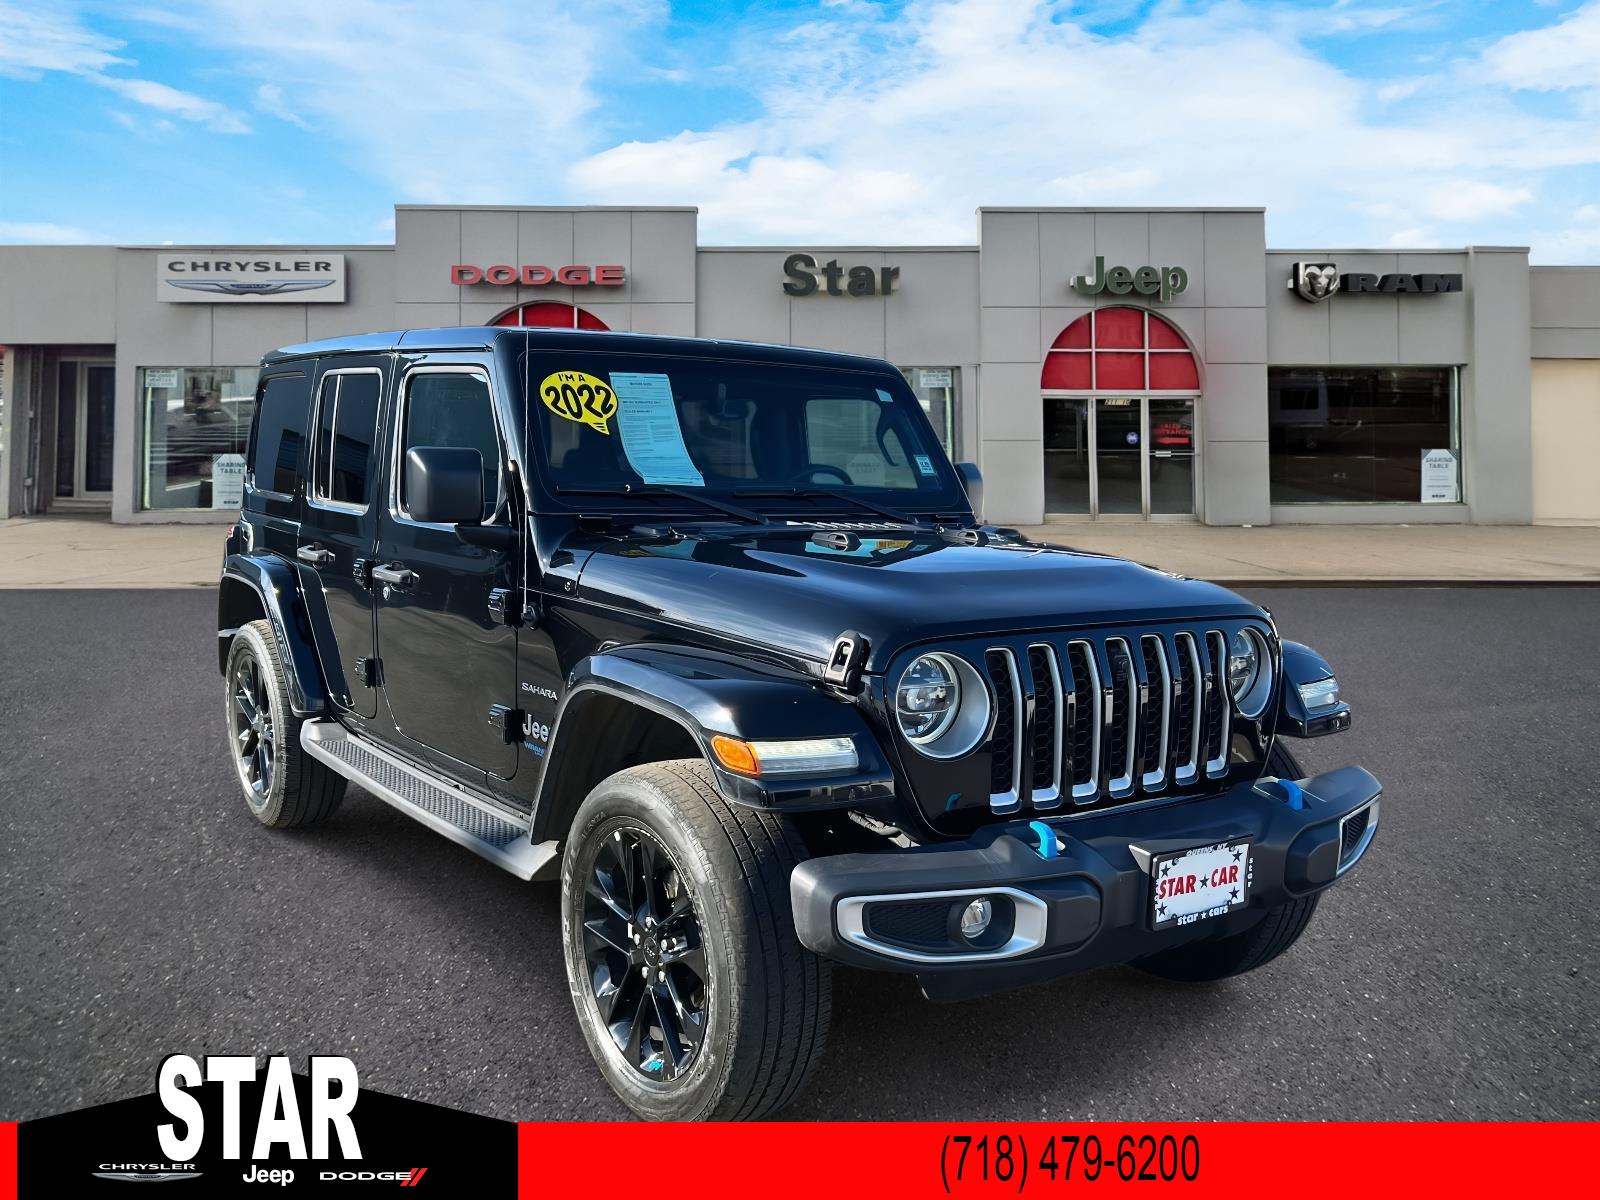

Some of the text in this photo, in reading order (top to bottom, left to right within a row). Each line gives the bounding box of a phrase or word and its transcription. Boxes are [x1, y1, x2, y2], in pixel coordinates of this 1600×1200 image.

[167, 261, 332, 273] CHRYSLER
[450, 264, 626, 286] DODGE
[782, 253, 901, 297] Star
[1070, 255, 1189, 301] Jeep
[1341, 272, 1463, 294] RAM
[558, 373, 587, 382] I'M A
[545, 383, 614, 420] 2022
[521, 682, 558, 701] SAHARA
[522, 713, 551, 743] Jee
[1158, 874, 1197, 900] STAR
[1211, 864, 1239, 888] CAR
[1177, 905, 1229, 926] star cars
